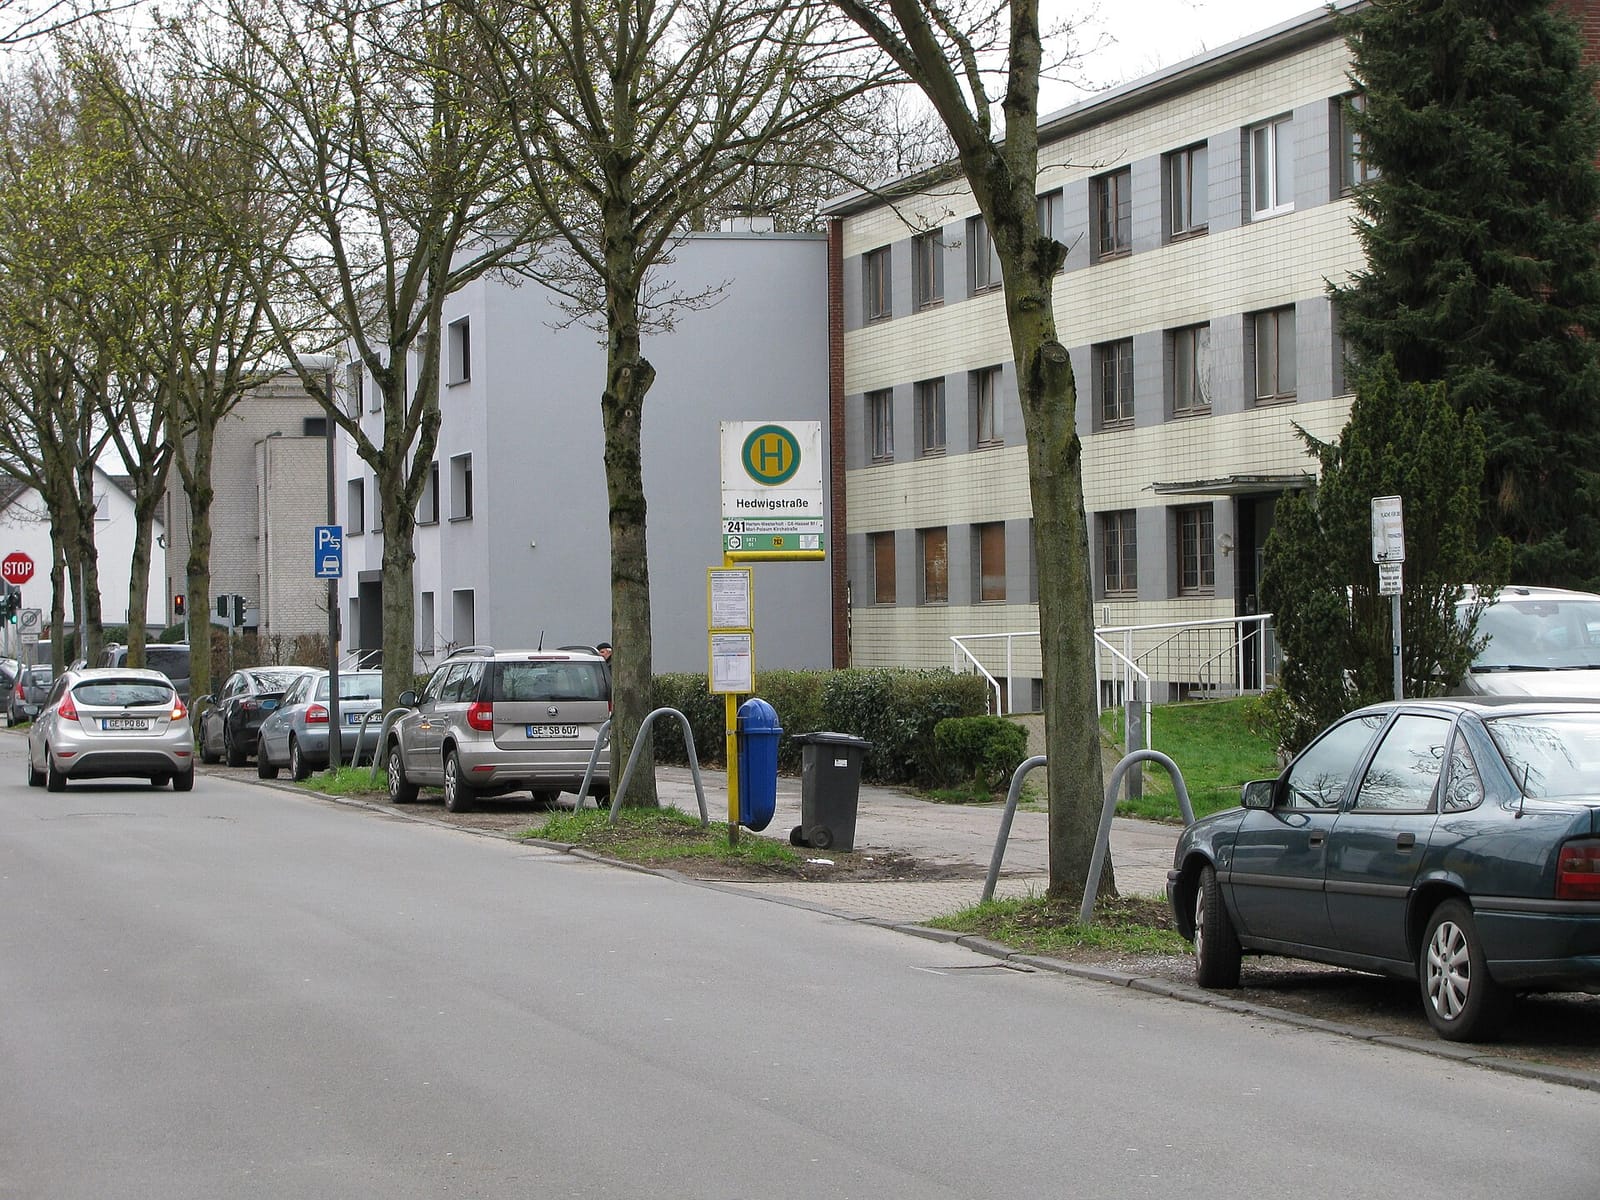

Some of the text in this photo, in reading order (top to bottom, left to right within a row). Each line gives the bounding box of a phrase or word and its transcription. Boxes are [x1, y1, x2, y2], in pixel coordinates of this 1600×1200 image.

[760, 439, 783, 471] H
[736, 499, 808, 510] Hedwigstraße
[728, 521, 745, 532] 241
[319, 529, 331, 550] P
[3, 561, 32, 575] STOP
[532, 726, 577, 735] GE SB 607
